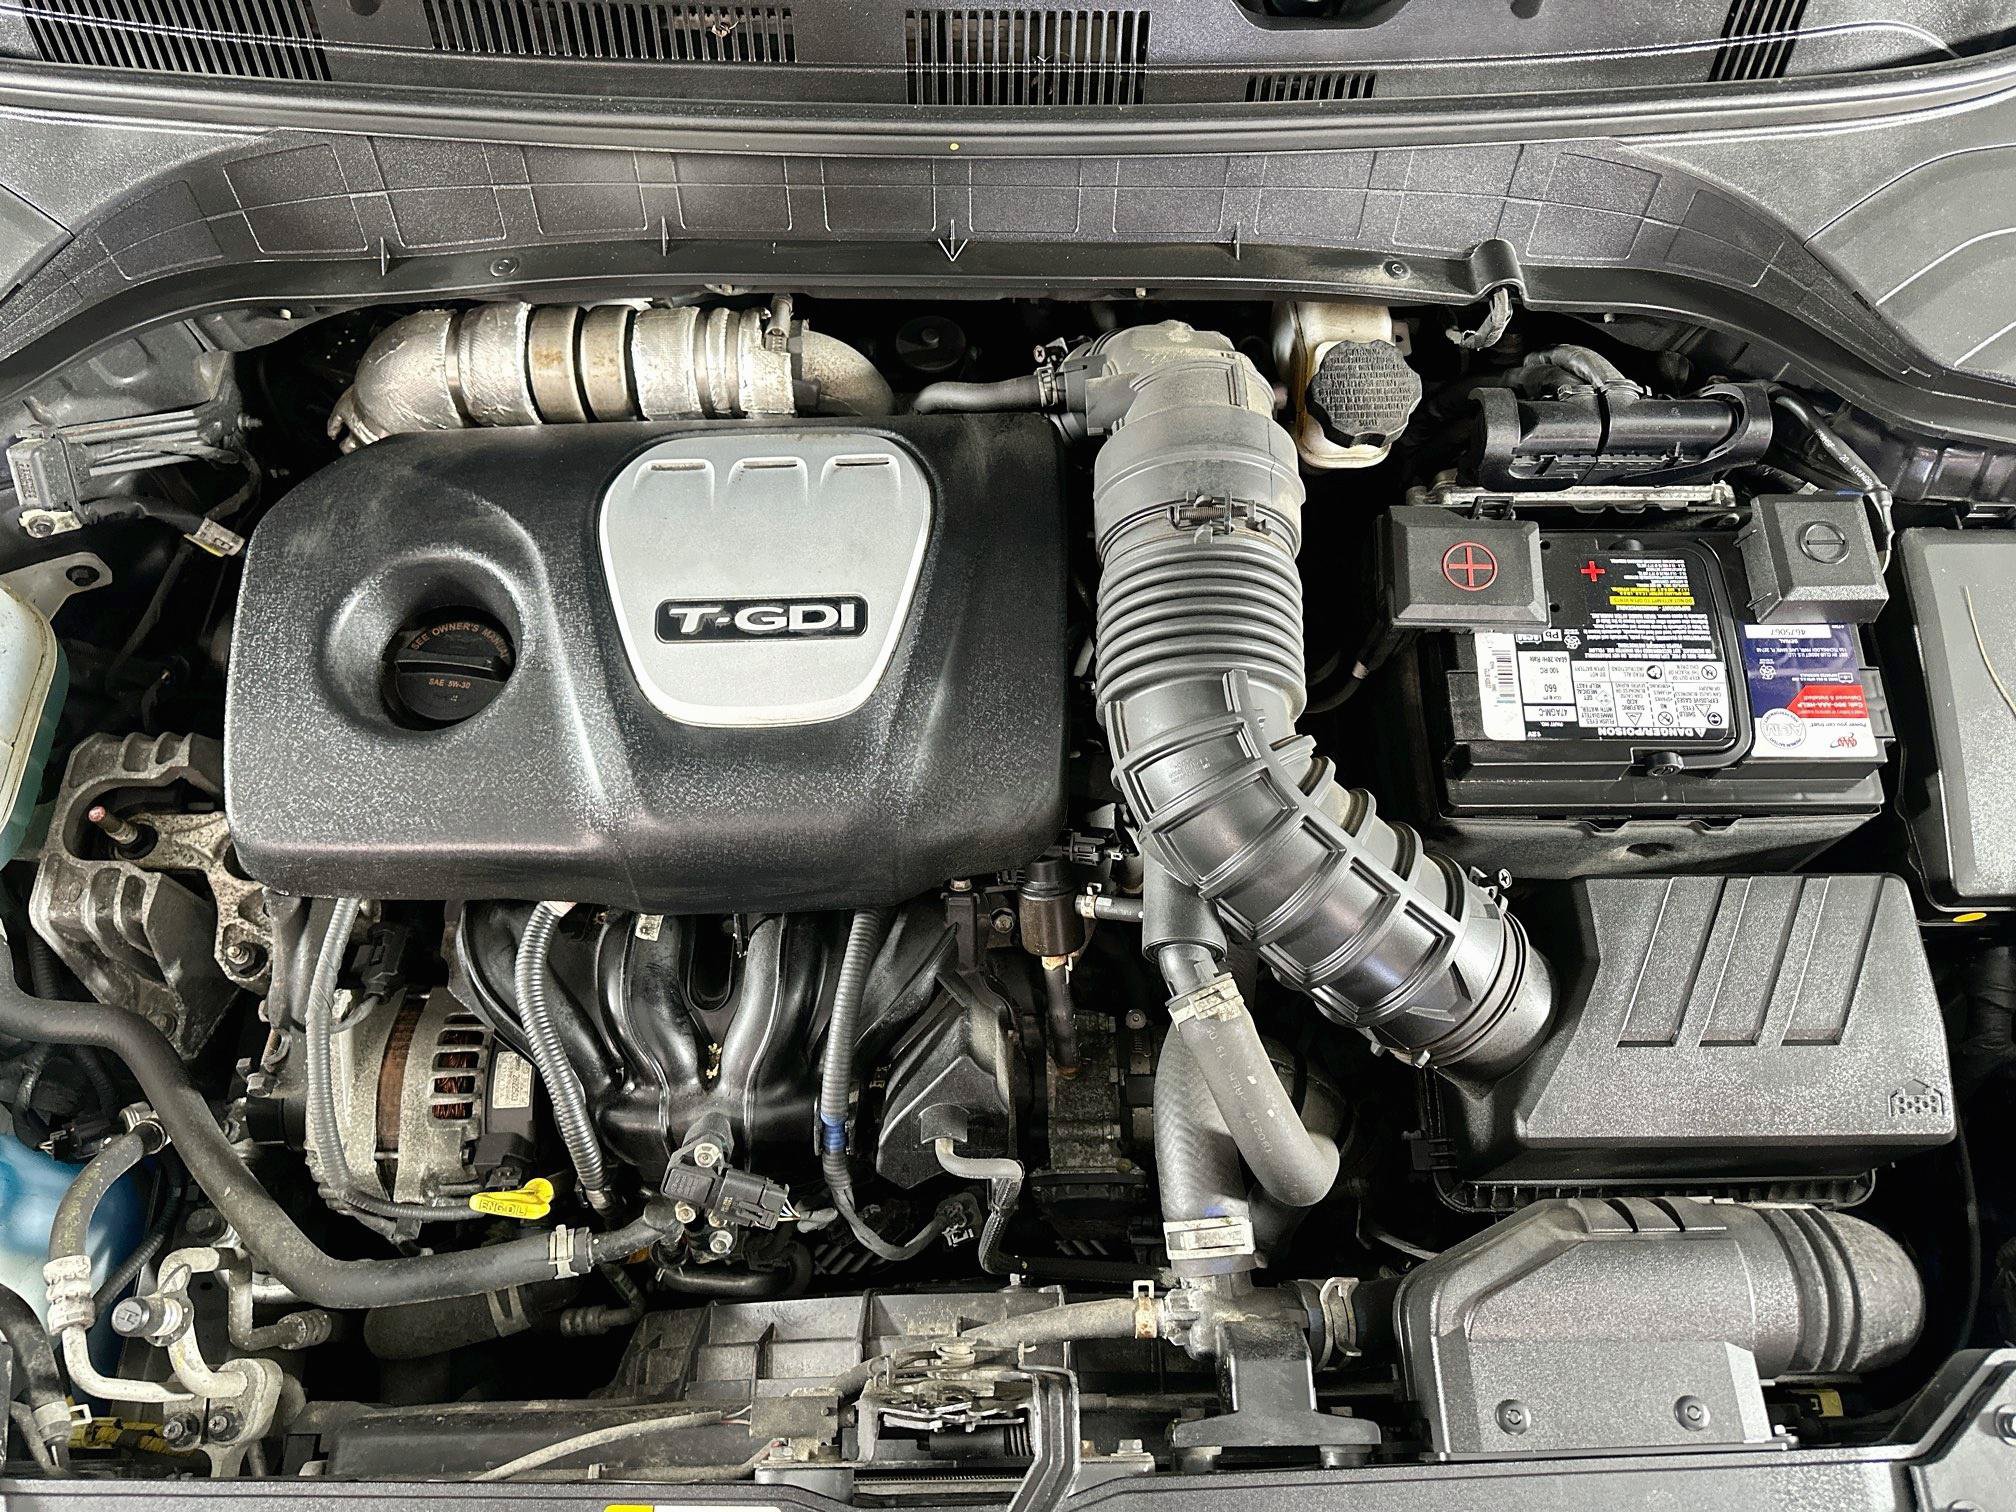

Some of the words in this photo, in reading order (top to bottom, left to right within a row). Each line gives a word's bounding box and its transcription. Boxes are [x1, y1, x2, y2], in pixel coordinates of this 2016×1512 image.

[669, 603, 855, 633] T-GDI
[411, 633, 430, 650] SEE
[432, 622, 480, 636] OWNER'S
[448, 680, 471, 689] 5W-30
[1544, 684, 1557, 692] 660
[1538, 708, 1567, 717] 47AGM-C
[1598, 728, 1694, 736] DANGER/POISON
[1765, 723, 1803, 736] AGM
